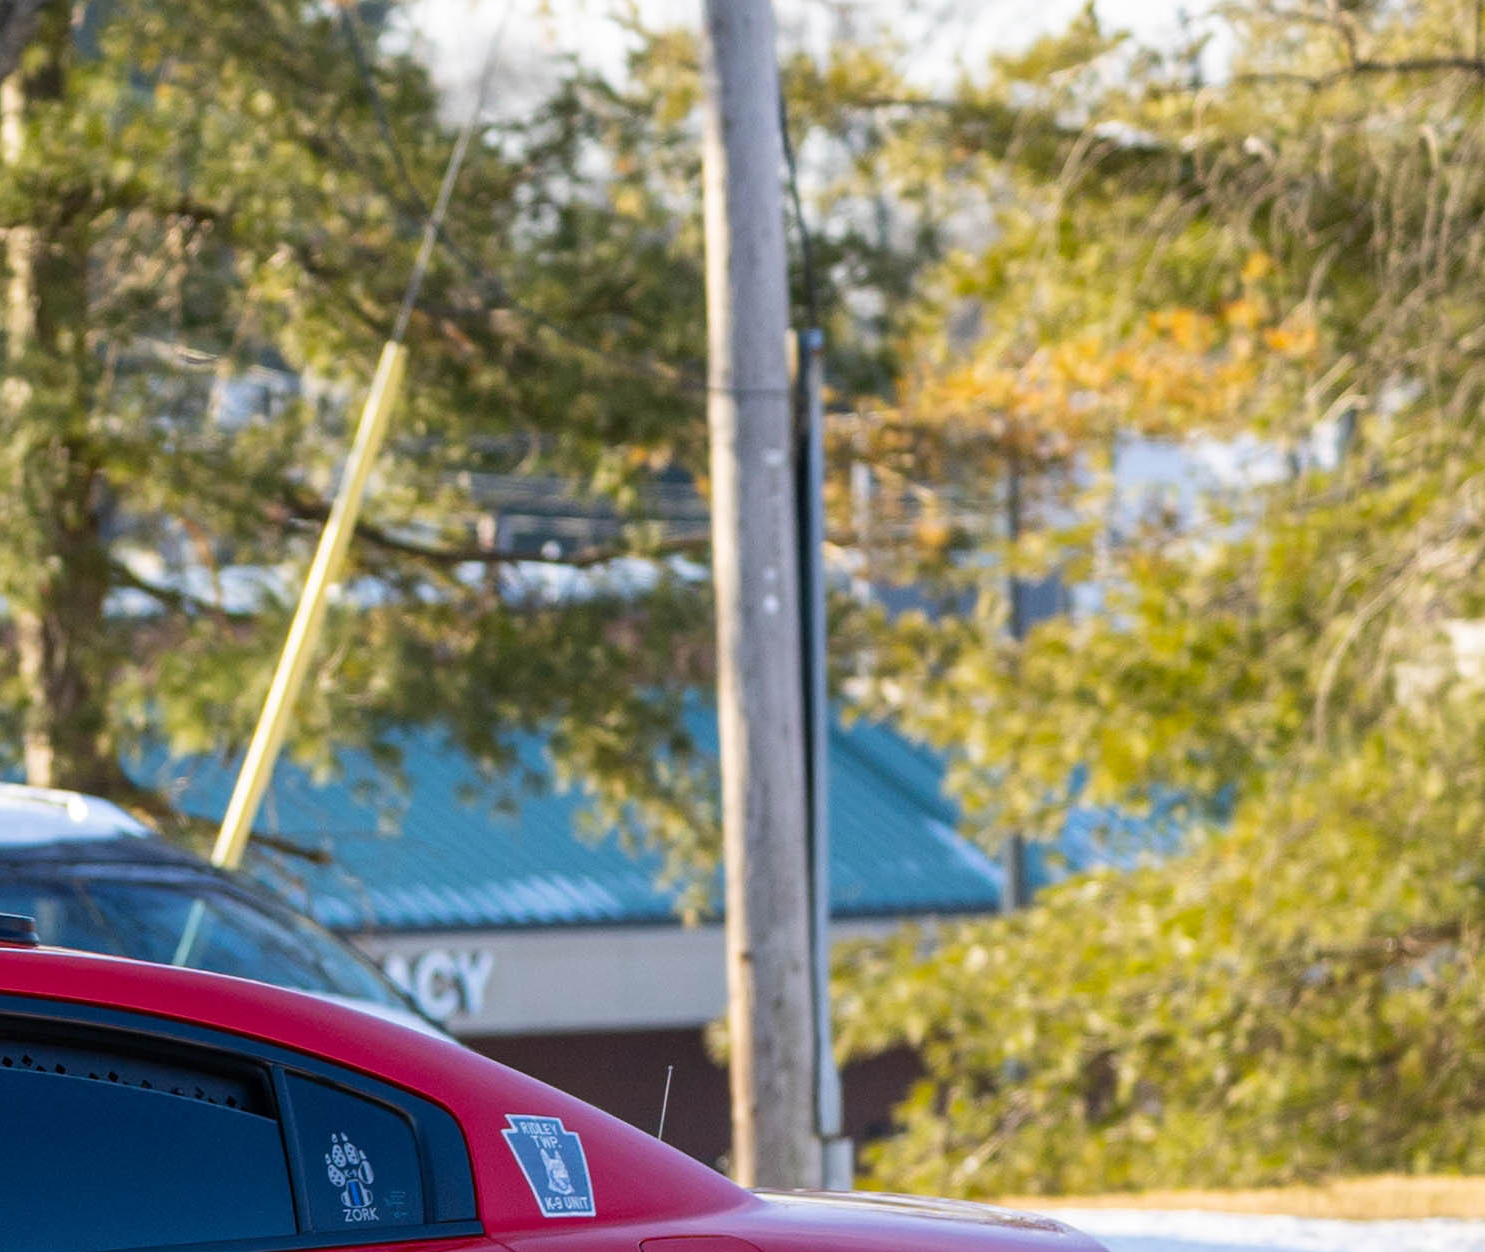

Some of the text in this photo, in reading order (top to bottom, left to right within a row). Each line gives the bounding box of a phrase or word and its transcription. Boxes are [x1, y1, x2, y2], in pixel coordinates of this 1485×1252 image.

[519, 1121, 558, 1135] RIDLEY
[530, 1135, 563, 1149] TWP.
[544, 1196, 589, 1210] K-9 UNIT
[343, 1207, 379, 1222] ZORK
